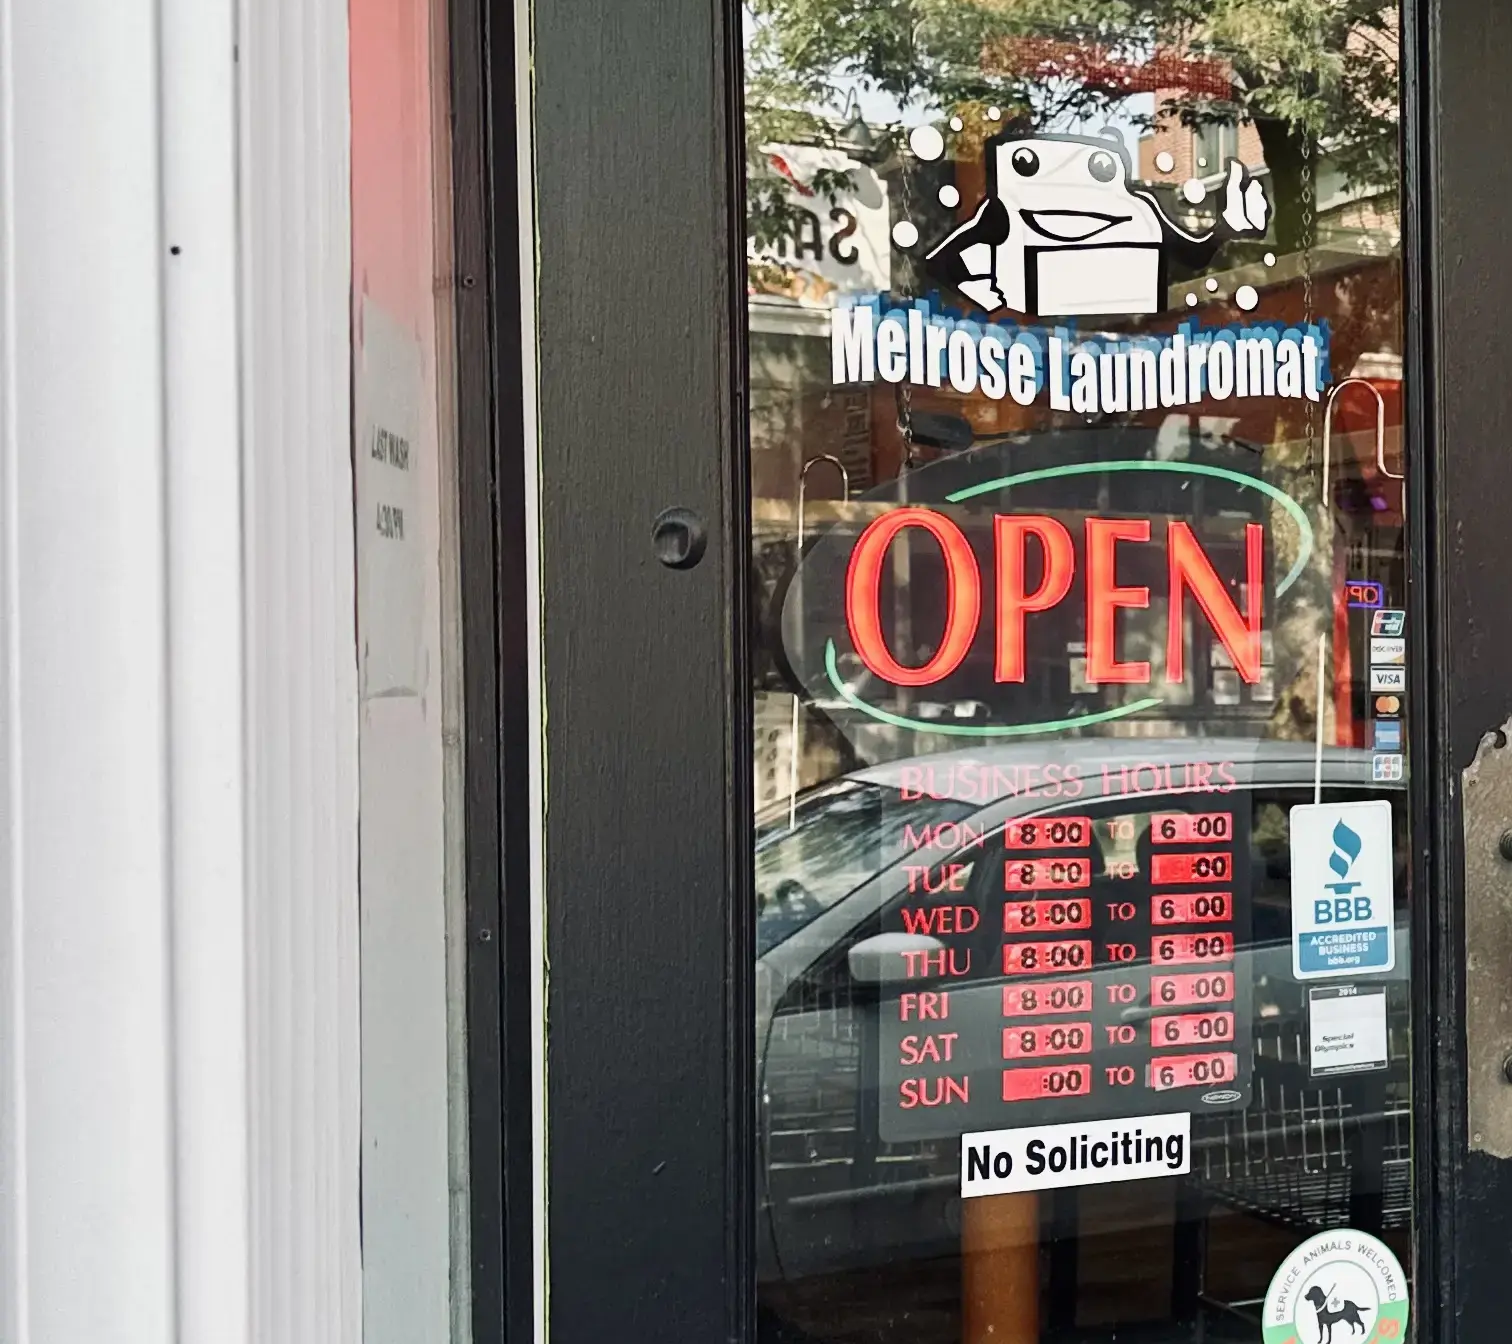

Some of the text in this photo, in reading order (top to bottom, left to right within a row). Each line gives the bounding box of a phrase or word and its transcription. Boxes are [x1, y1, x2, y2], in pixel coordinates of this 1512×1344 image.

[831, 305, 1322, 413] Melrose Laundromat
[844, 507, 1265, 687] OPEN
[1376, 674, 1401, 685] VISA
[900, 760, 1238, 801] BUSINESS HOURS
[902, 821, 985, 851] MON
[1106, 820, 1134, 840] TO
[903, 863, 965, 894] TUE
[1106, 861, 1134, 880] TO
[902, 905, 980, 935] WED
[1106, 902, 1136, 921] TO
[1314, 896, 1373, 925] BBB
[1310, 931, 1377, 946] ACCREDITED
[1318, 942, 1369, 956] BUSINESS
[902, 948, 971, 977] THU
[1106, 943, 1136, 962] TO
[1327, 954, 1361, 966] bbb.org
[900, 993, 950, 1021] FRI
[1106, 984, 1136, 1003] TO
[900, 1032, 959, 1065] SAT
[1106, 1025, 1136, 1045] TO
[900, 1076, 969, 1108] SUN
[1105, 1066, 1135, 1086] TO
[967, 1127, 1185, 1182] No Soliciting
[1276, 1240, 1398, 1322] SERVICE ANIMALS WELCOMED
